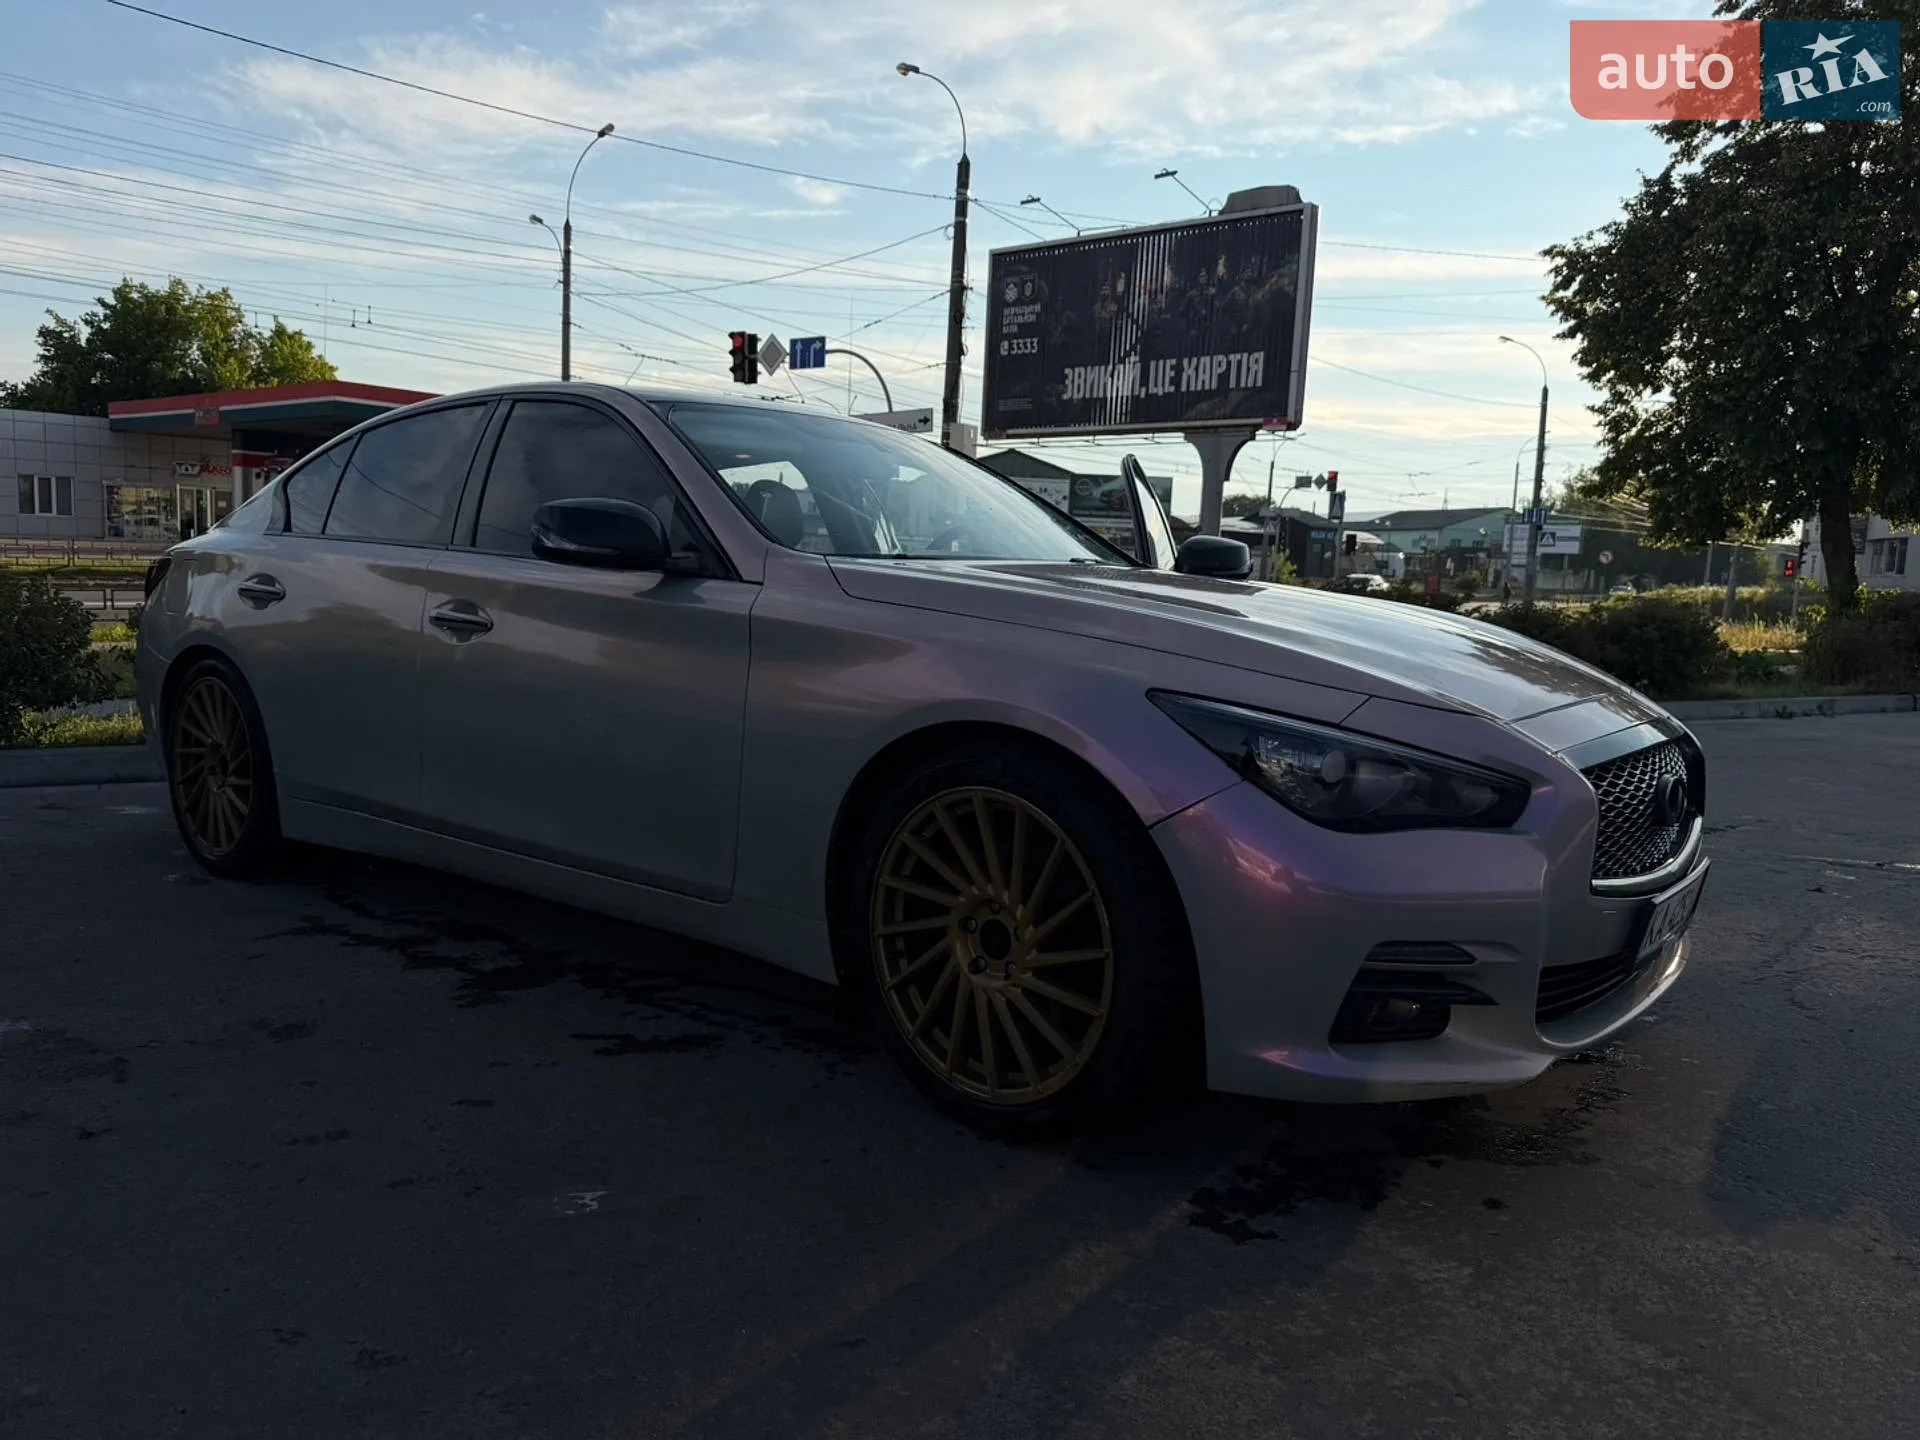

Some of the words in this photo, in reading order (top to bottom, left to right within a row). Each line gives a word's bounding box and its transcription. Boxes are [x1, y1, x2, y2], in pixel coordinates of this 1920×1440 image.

[1010, 337, 1039, 354] 3333
[1148, 358, 1177, 396] ЦЕ
[1180, 351, 1265, 392] ХАРТІЯ
